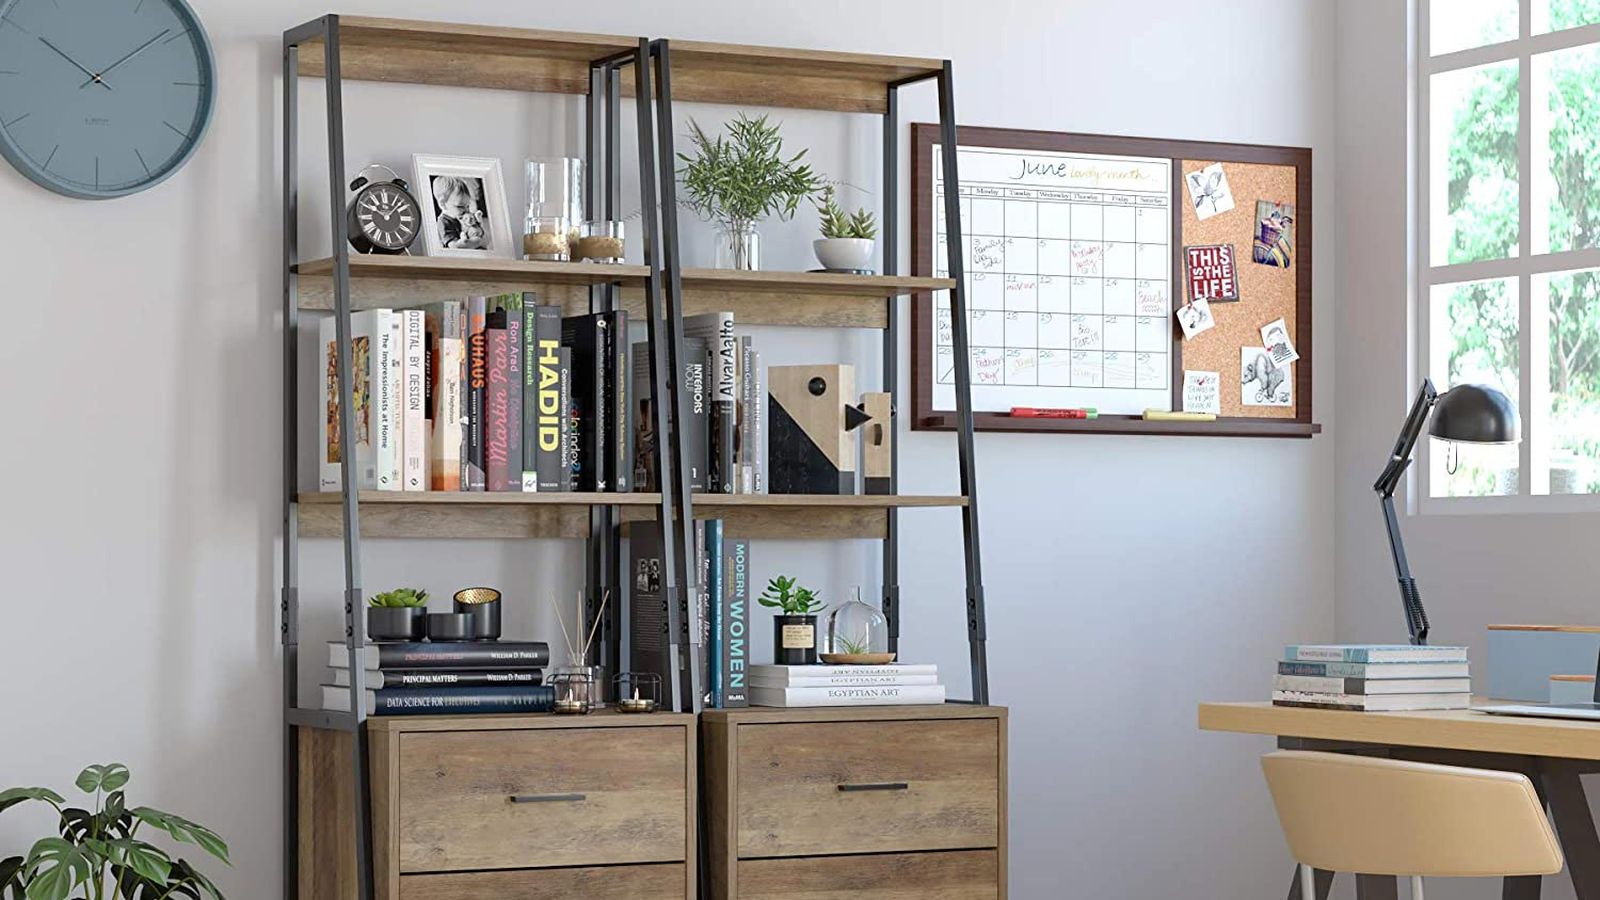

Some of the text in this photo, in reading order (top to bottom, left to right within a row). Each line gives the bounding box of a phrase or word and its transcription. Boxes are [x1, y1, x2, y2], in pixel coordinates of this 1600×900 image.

[1008, 158, 1066, 180] June
[1190, 248, 1231, 266] THIS
[1204, 266, 1232, 279] THE
[1194, 279, 1233, 299] LIFE
[510, 321, 519, 343] Ron
[526, 312, 535, 343] Design
[409, 311, 420, 411] DIGITAL BY DESIGN
[489, 332, 508, 384] Parr
[510, 347, 519, 372] Arad
[527, 344, 535, 385] Research
[382, 350, 390, 412] Impressionists
[693, 363, 702, 414] INTERIORS
[538, 340, 560, 452] HADID
[382, 413, 389, 423] at
[735, 544, 745, 597] MODERN
[730, 600, 744, 688] WOMEN
[402, 675, 431, 683] PRINCIPAL
[432, 674, 458, 683] MATTERS
[387, 697, 403, 708] DATA
[404, 696, 430, 707] SCIENCE
[431, 696, 444, 707] FOR
[828, 688, 900, 697] EGYPTIAN ART
